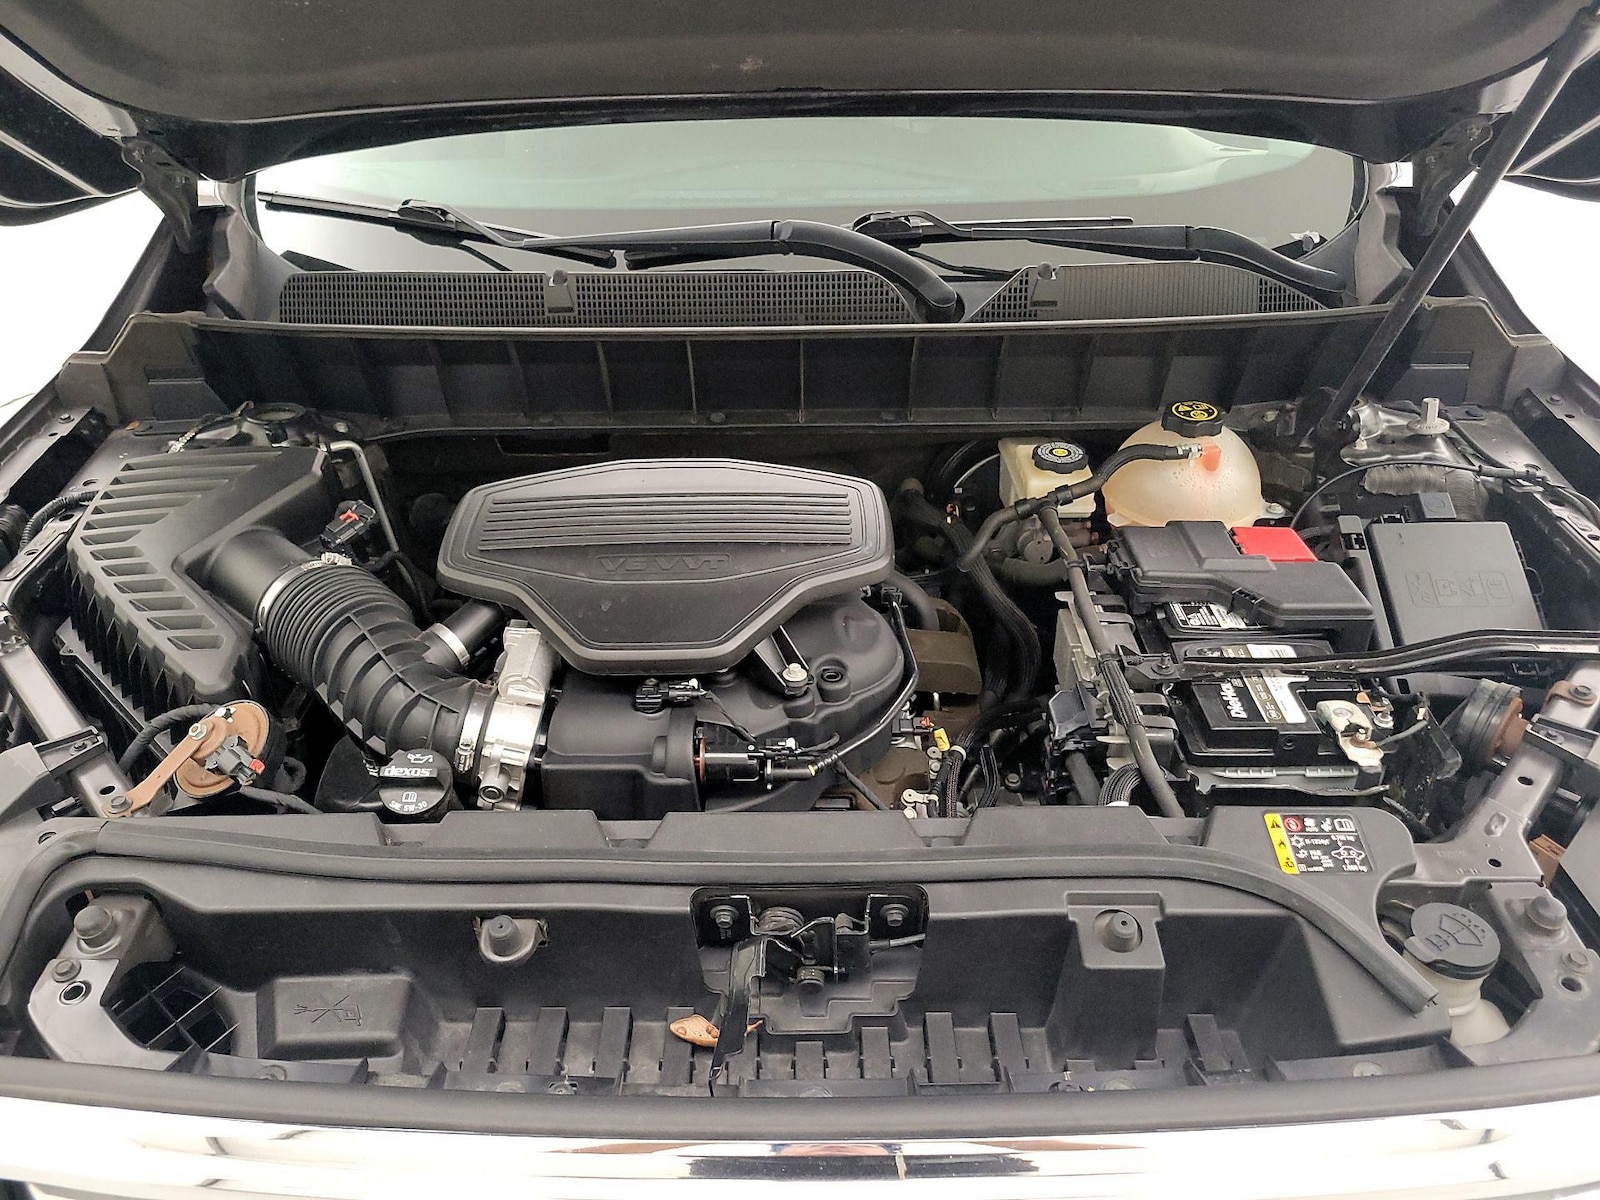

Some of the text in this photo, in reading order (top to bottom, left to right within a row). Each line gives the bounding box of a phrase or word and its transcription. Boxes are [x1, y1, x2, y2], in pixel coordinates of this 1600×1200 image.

[655, 556, 725, 570] VVT
[384, 765, 432, 777] dexos
[403, 800, 427, 811] 5W-30
